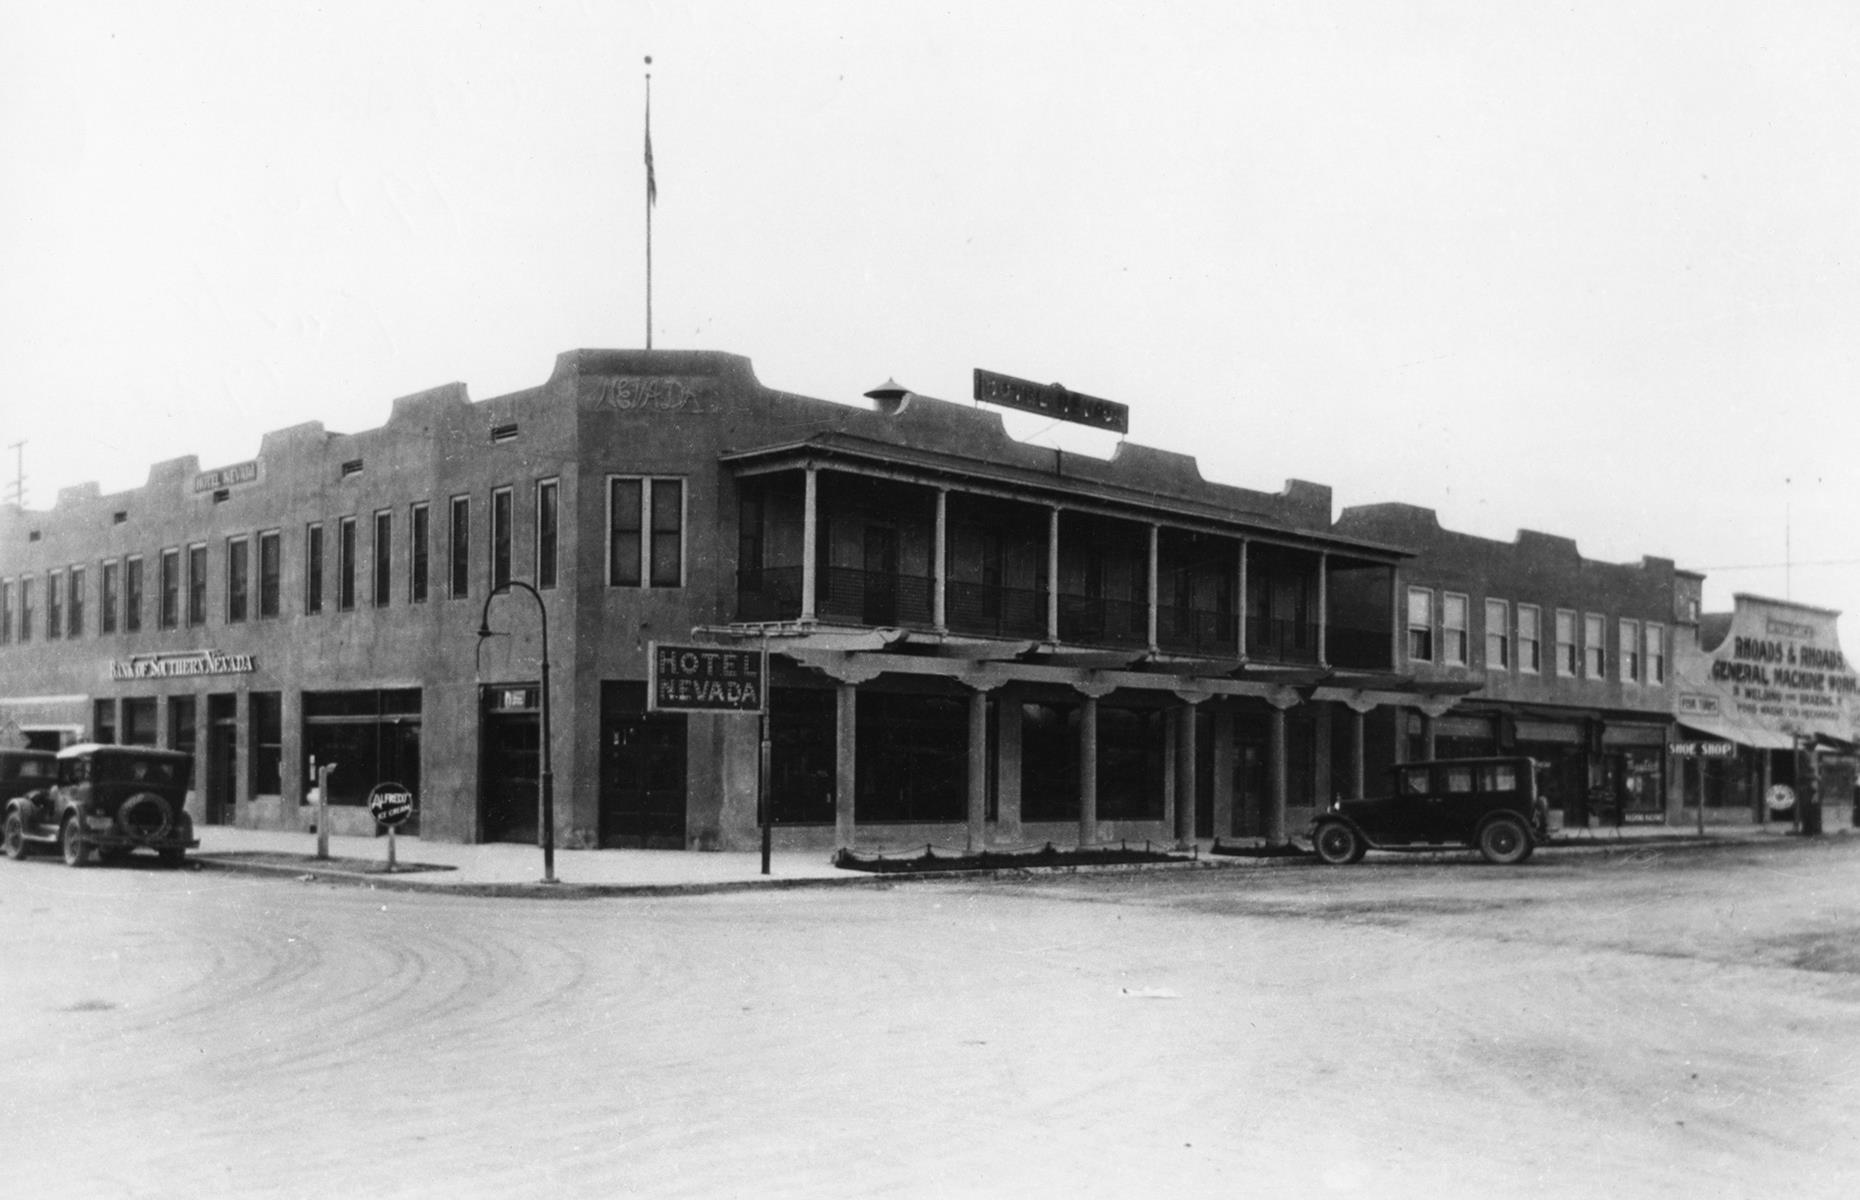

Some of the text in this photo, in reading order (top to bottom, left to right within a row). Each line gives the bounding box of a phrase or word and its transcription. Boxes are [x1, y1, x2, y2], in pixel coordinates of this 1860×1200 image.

[595, 379, 704, 413] NEVADA
[110, 650, 256, 678] BANK OF SOUTHERN NEVADA
[660, 650, 757, 677] HOTEL
[1735, 635, 1783, 664] RHOADS
[1787, 641, 1797, 665] &
[1712, 659, 1770, 686] GENERAL
[1774, 667, 1825, 691] MACHINE
[660, 679, 757, 703] NEVADA
[1669, 743, 1732, 756] SHOE SHOP
